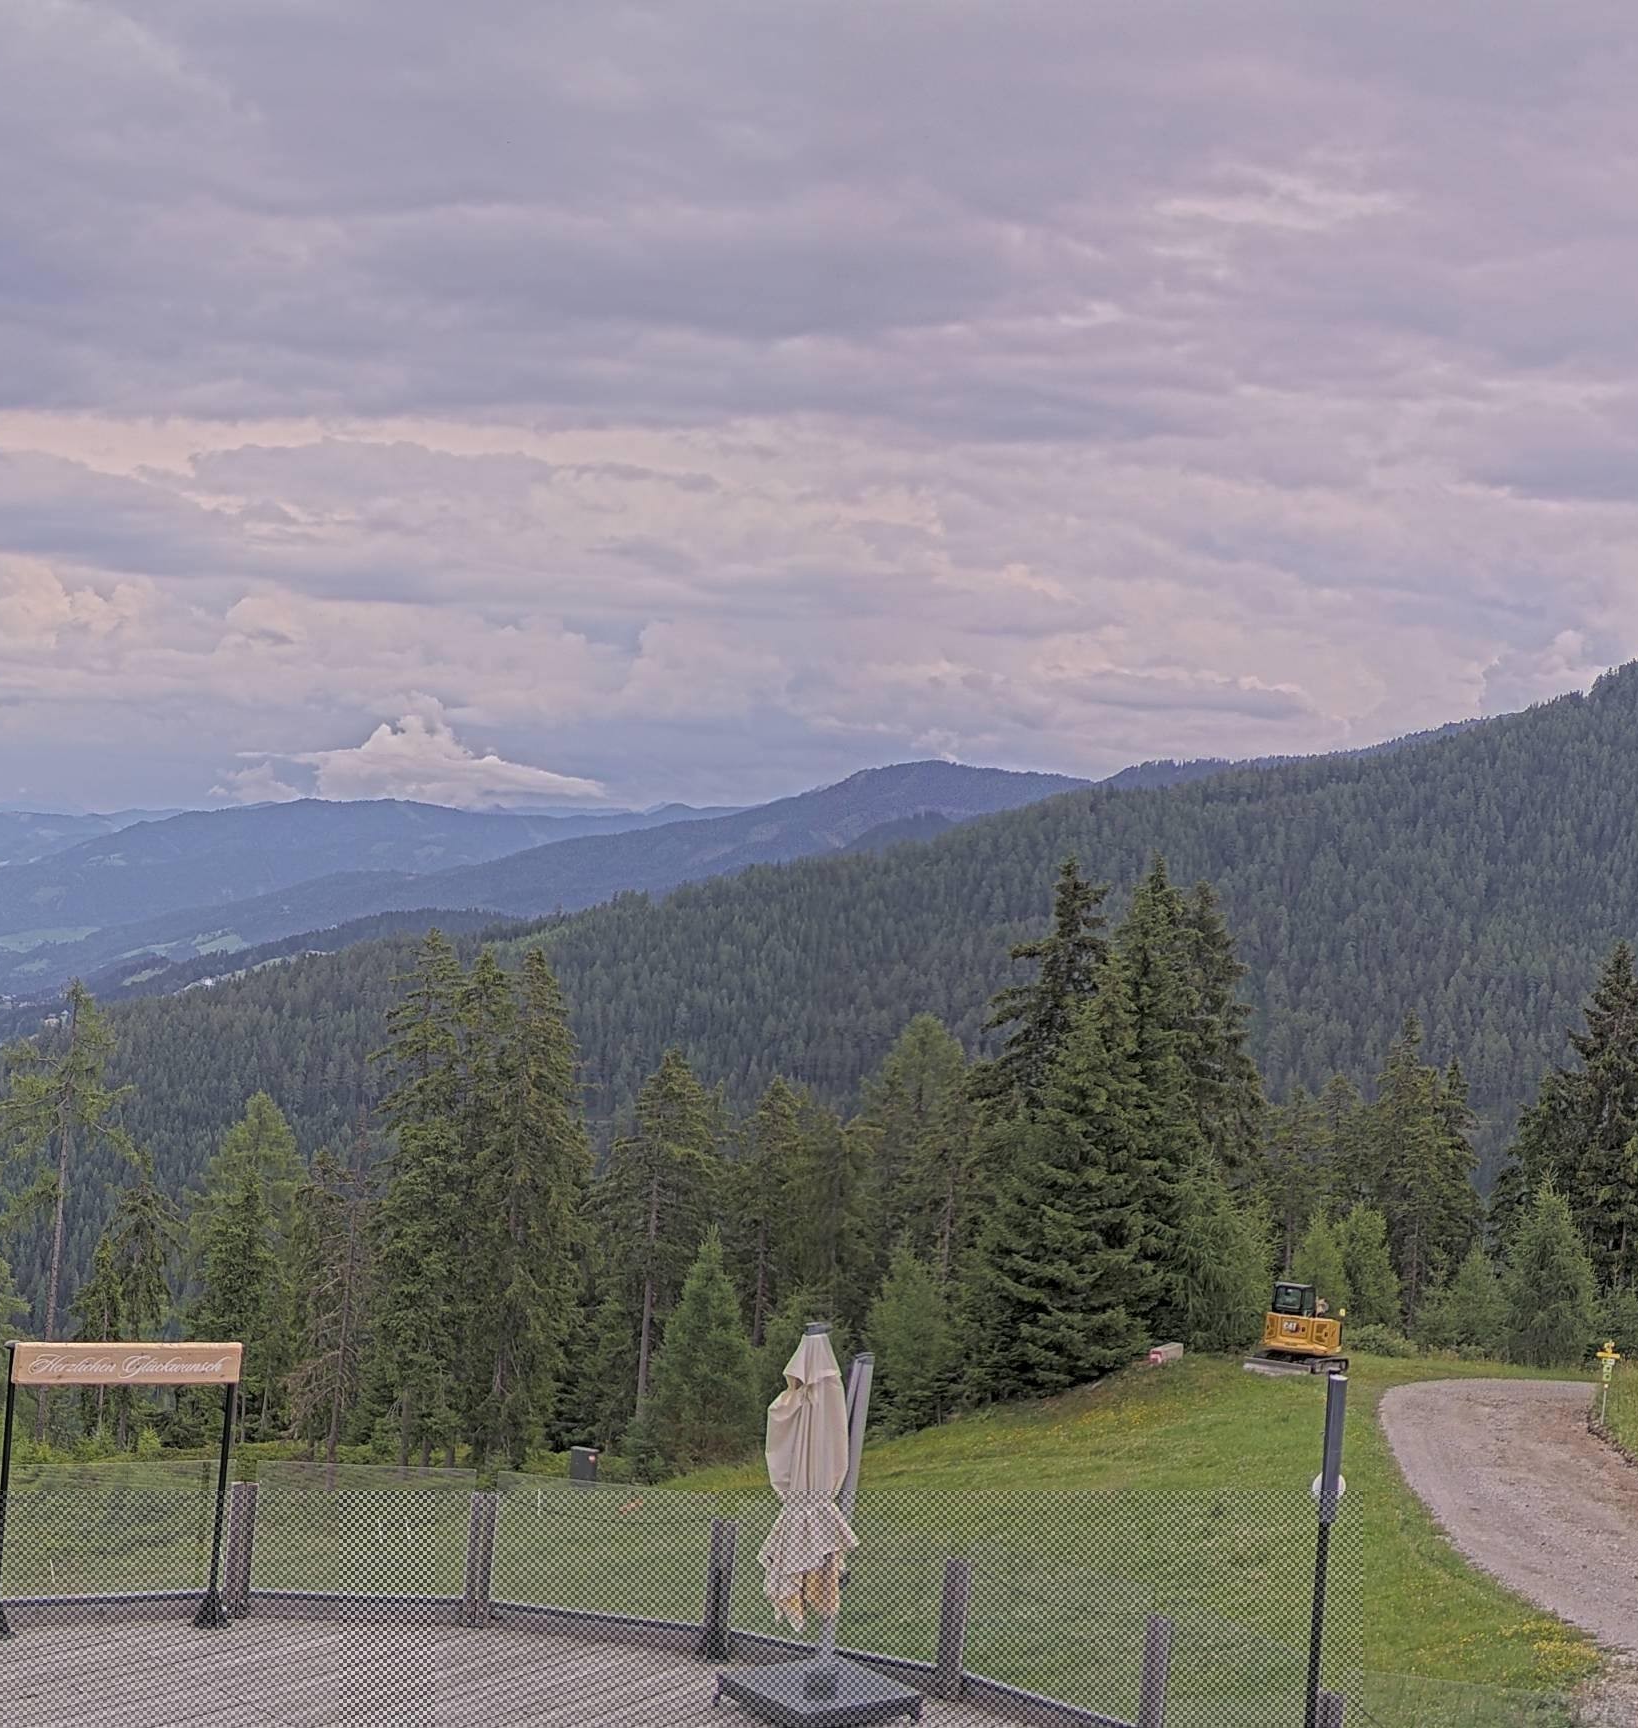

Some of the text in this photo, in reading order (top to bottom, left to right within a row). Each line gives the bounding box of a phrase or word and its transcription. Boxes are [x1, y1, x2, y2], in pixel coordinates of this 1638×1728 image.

[1283, 1321, 1297, 1332] CAT
[28, 1353, 233, 1379] Herzlichen Glückwunsch
